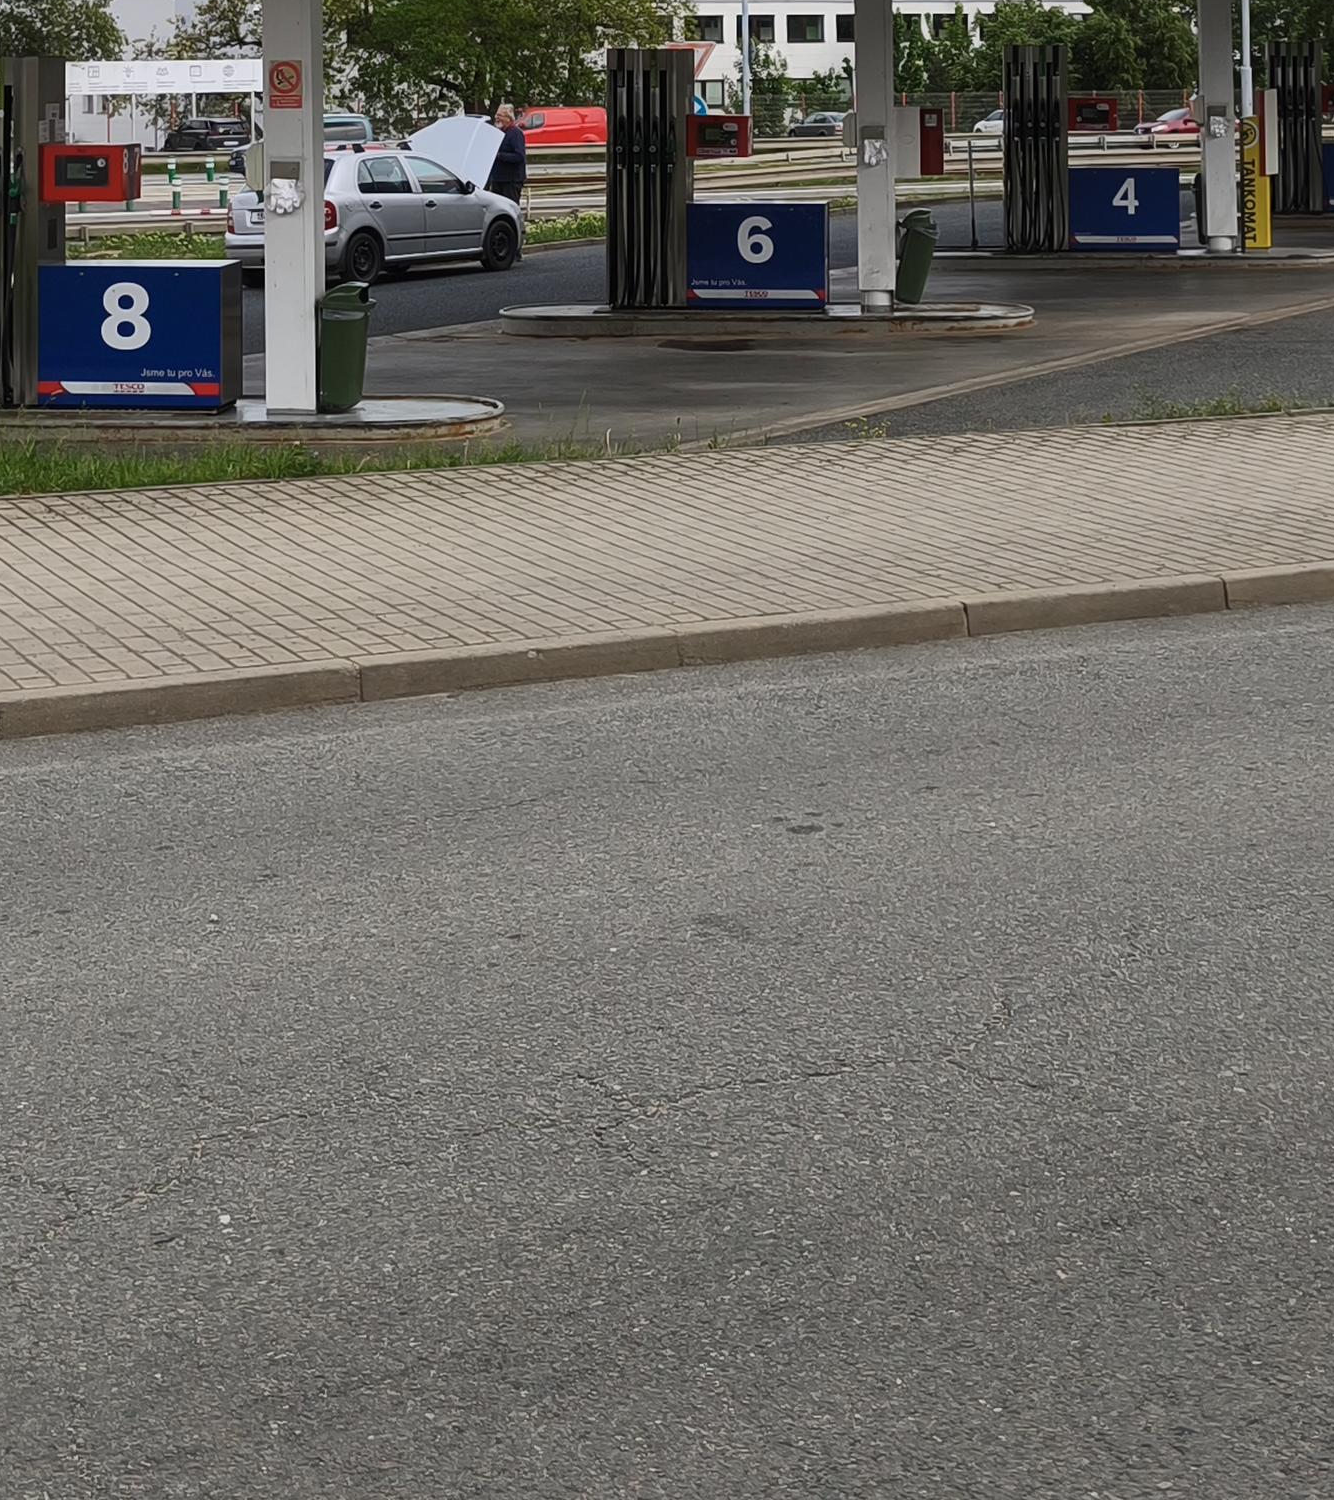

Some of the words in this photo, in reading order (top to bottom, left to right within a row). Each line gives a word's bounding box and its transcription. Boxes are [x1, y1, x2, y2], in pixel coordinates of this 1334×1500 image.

[1112, 177, 1139, 215] 4
[1243, 158, 1256, 243] TANKOMAT
[737, 215, 774, 264] 6
[101, 282, 152, 350] 8
[113, 383, 145, 391] TESCO
[141, 368, 165, 378] Jsme
[167, 368, 176, 378] tu
[178, 370, 193, 380] pro
[195, 367, 216, 378] Vás.
